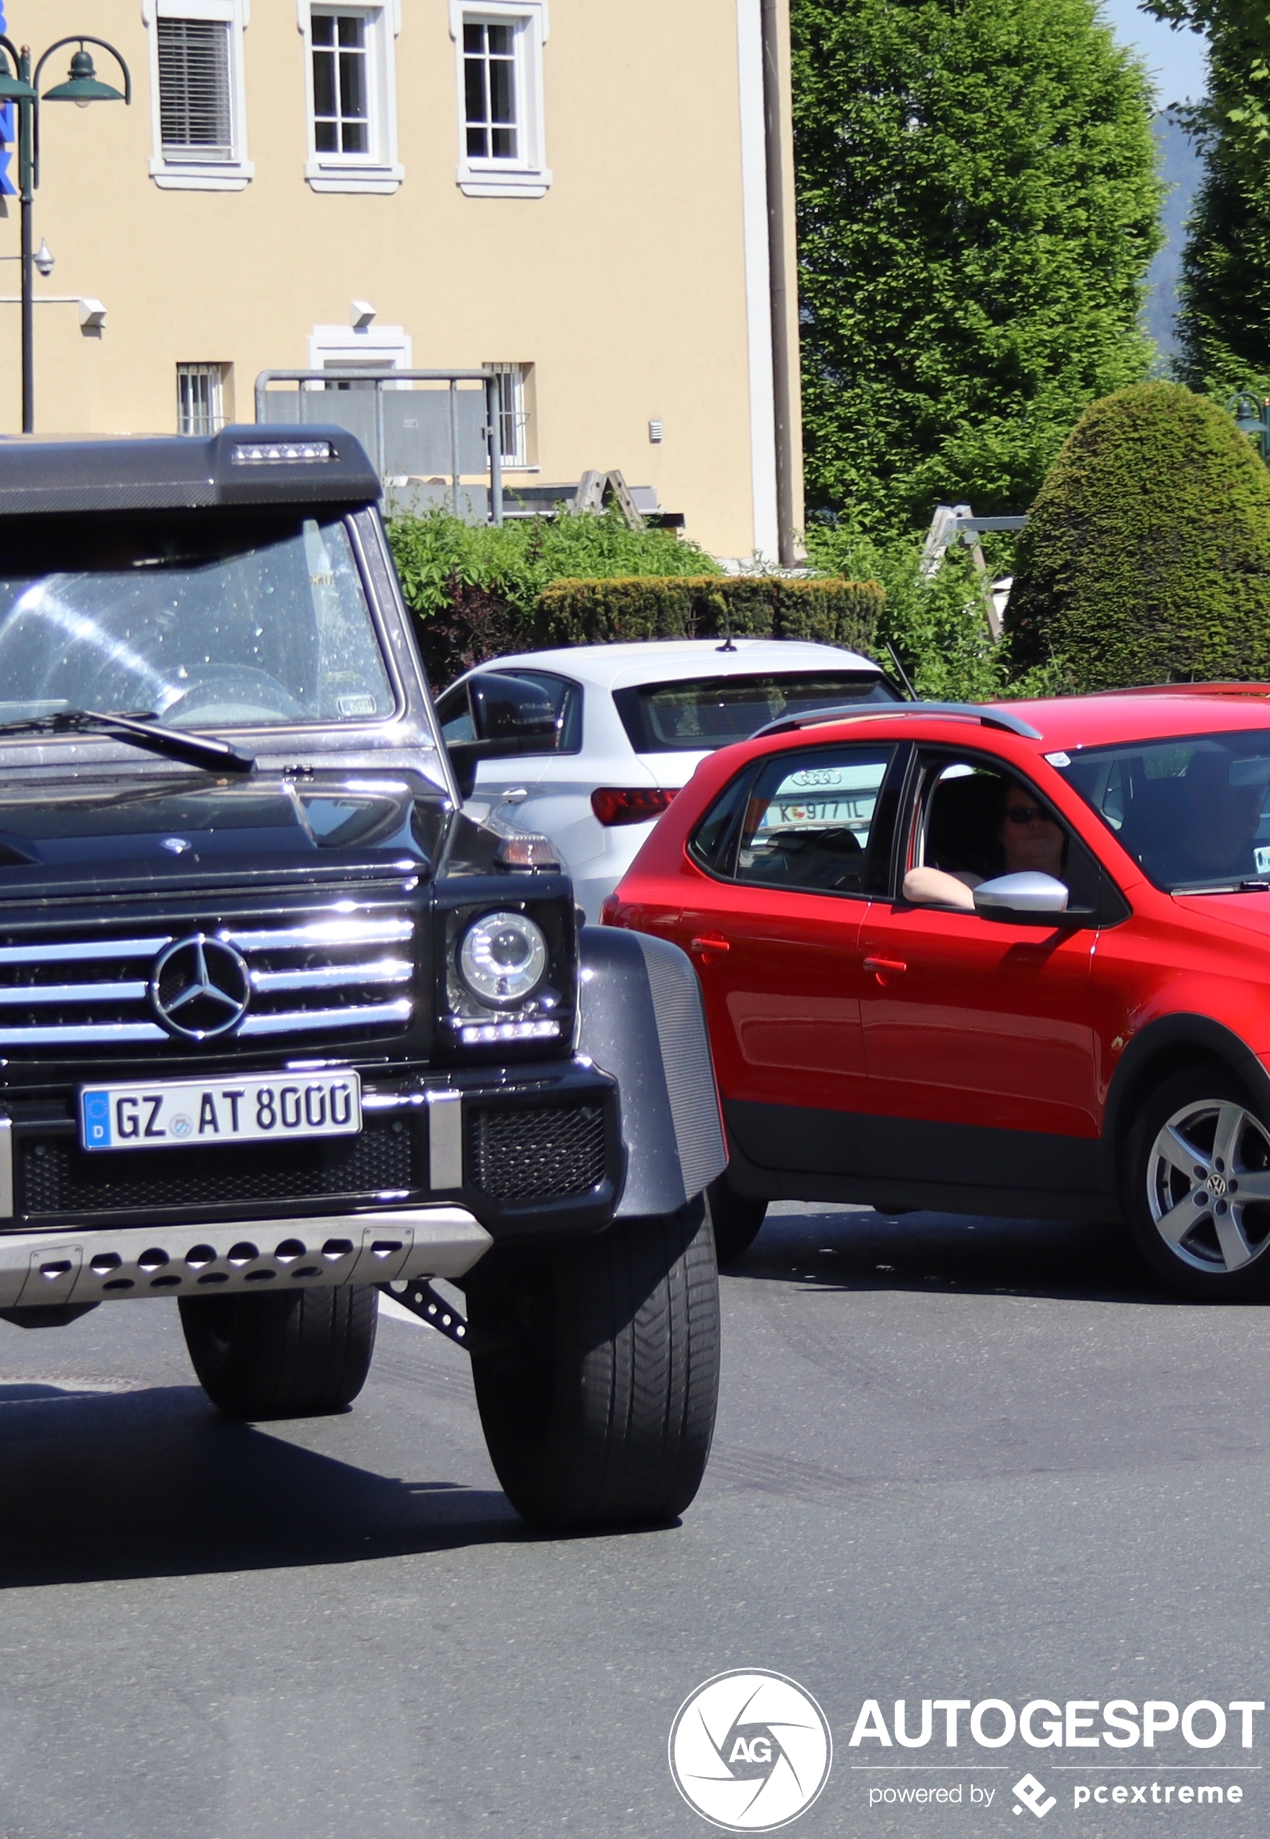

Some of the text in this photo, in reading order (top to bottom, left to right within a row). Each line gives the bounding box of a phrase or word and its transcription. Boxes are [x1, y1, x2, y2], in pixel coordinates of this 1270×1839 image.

[779, 803, 792, 823] K
[806, 801, 841, 820] 977
[116, 1080, 353, 1138] GZ AT 8000
[93, 1125, 104, 1138] D
